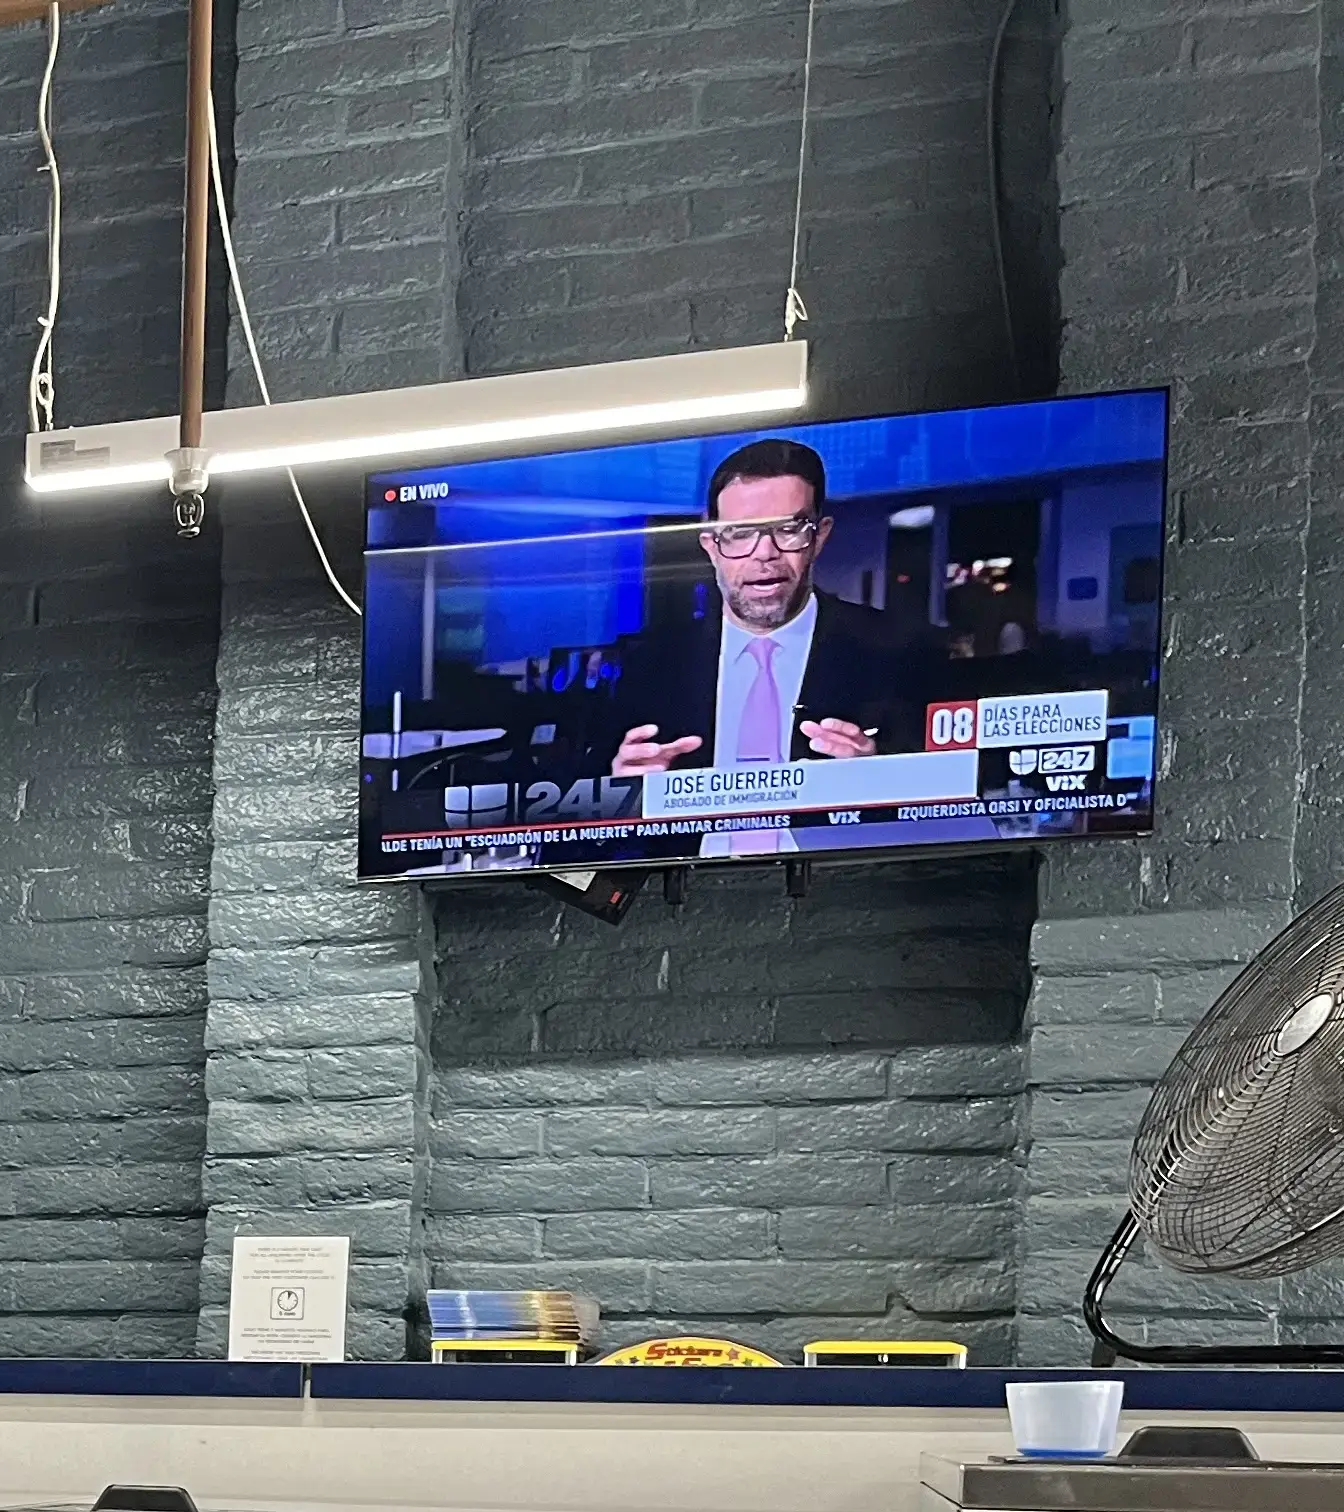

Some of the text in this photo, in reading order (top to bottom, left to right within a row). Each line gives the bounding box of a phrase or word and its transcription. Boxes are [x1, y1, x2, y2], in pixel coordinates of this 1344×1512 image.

[400, 482, 448, 502] EN VIVO
[984, 703, 1061, 724] DÍAS PARA
[931, 707, 974, 745] 08
[983, 716, 1102, 738] LAS ELECCIONES
[664, 768, 804, 795] JOSÉ GUERRERO
[714, 795, 726, 806] DE
[897, 801, 986, 821] IZQUIERDISTA
[988, 800, 1020, 815] ORSI
[1022, 798, 1032, 812] Y
[1034, 794, 1114, 811] OFICIALISTA
[410, 835, 443, 851] TENÍA
[445, 836, 462, 849] UN
[544, 830, 559, 843] DE
[562, 828, 577, 842] LA
[637, 822, 669, 837] PARA
[671, 820, 712, 835] MATAR
[715, 814, 791, 831] CRIMINALES
